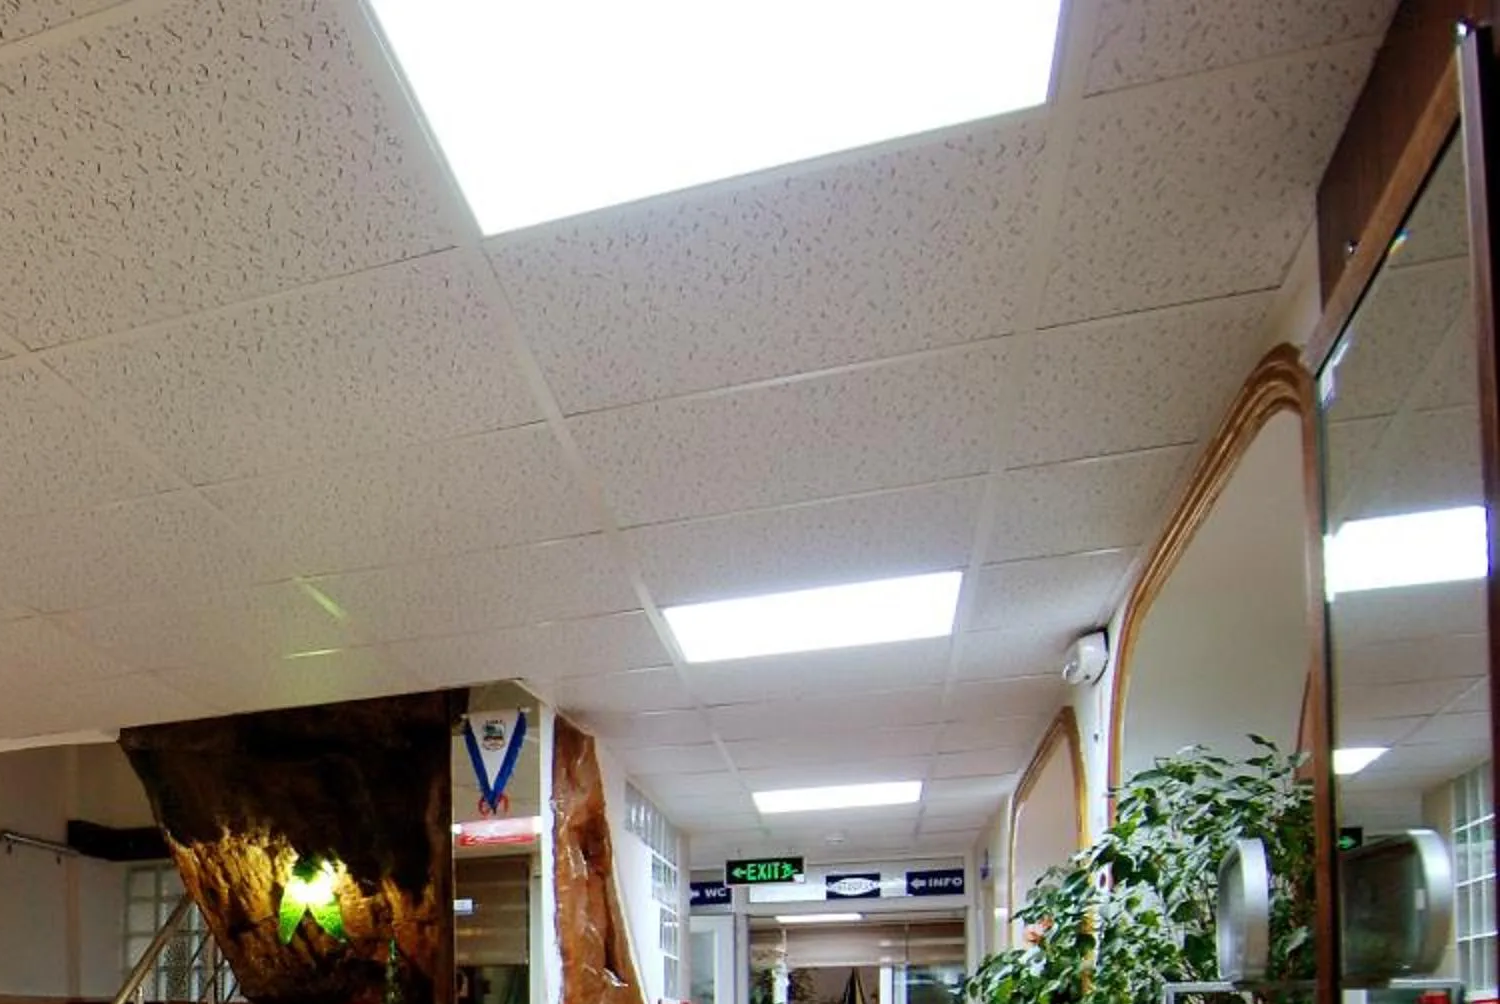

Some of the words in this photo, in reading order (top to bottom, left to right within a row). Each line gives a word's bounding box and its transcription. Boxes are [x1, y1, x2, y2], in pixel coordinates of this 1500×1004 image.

[746, 862, 781, 881] EXIT
[927, 876, 963, 888] INFO
[704, 887, 728, 898] WC
